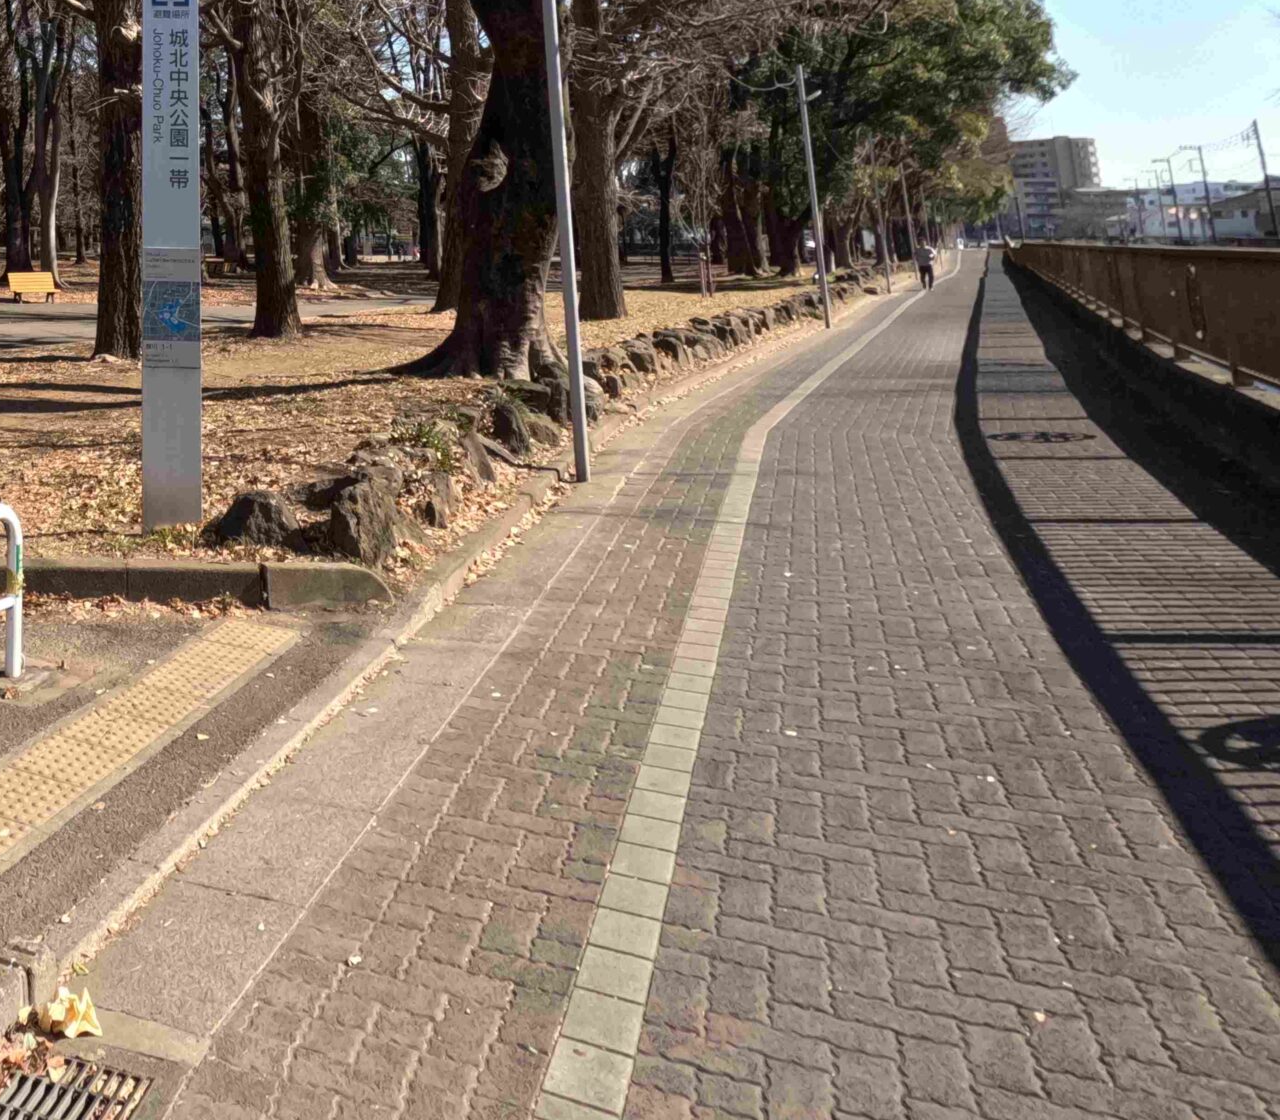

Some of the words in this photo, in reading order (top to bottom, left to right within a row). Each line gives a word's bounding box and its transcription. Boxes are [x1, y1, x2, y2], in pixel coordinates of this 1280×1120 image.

[153, 29, 164, 111] Johoku-Chuo
[169, 29, 189, 189] 城北中央公園一帯
[153, 116, 164, 144] Park
